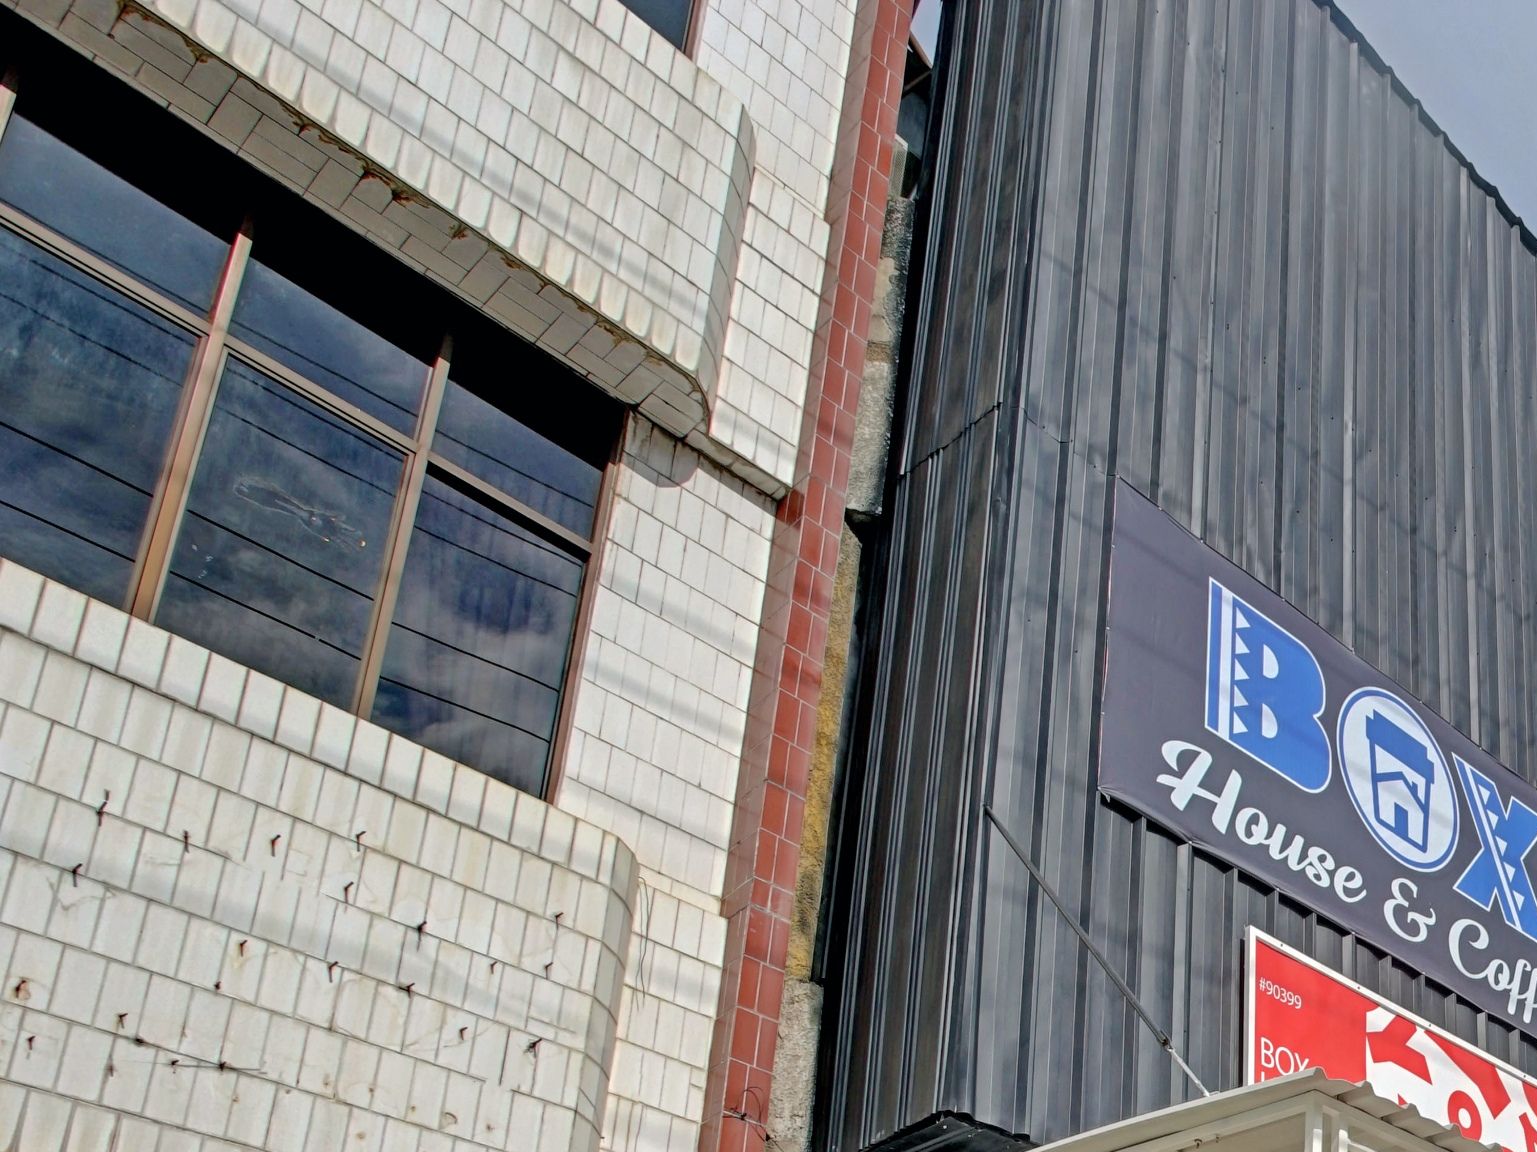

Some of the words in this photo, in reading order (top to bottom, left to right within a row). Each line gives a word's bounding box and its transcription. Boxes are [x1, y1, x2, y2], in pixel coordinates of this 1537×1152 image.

[1156, 740, 1367, 903] House
[1383, 877, 1436, 942] &
[1259, 977, 1302, 1009] #90399
